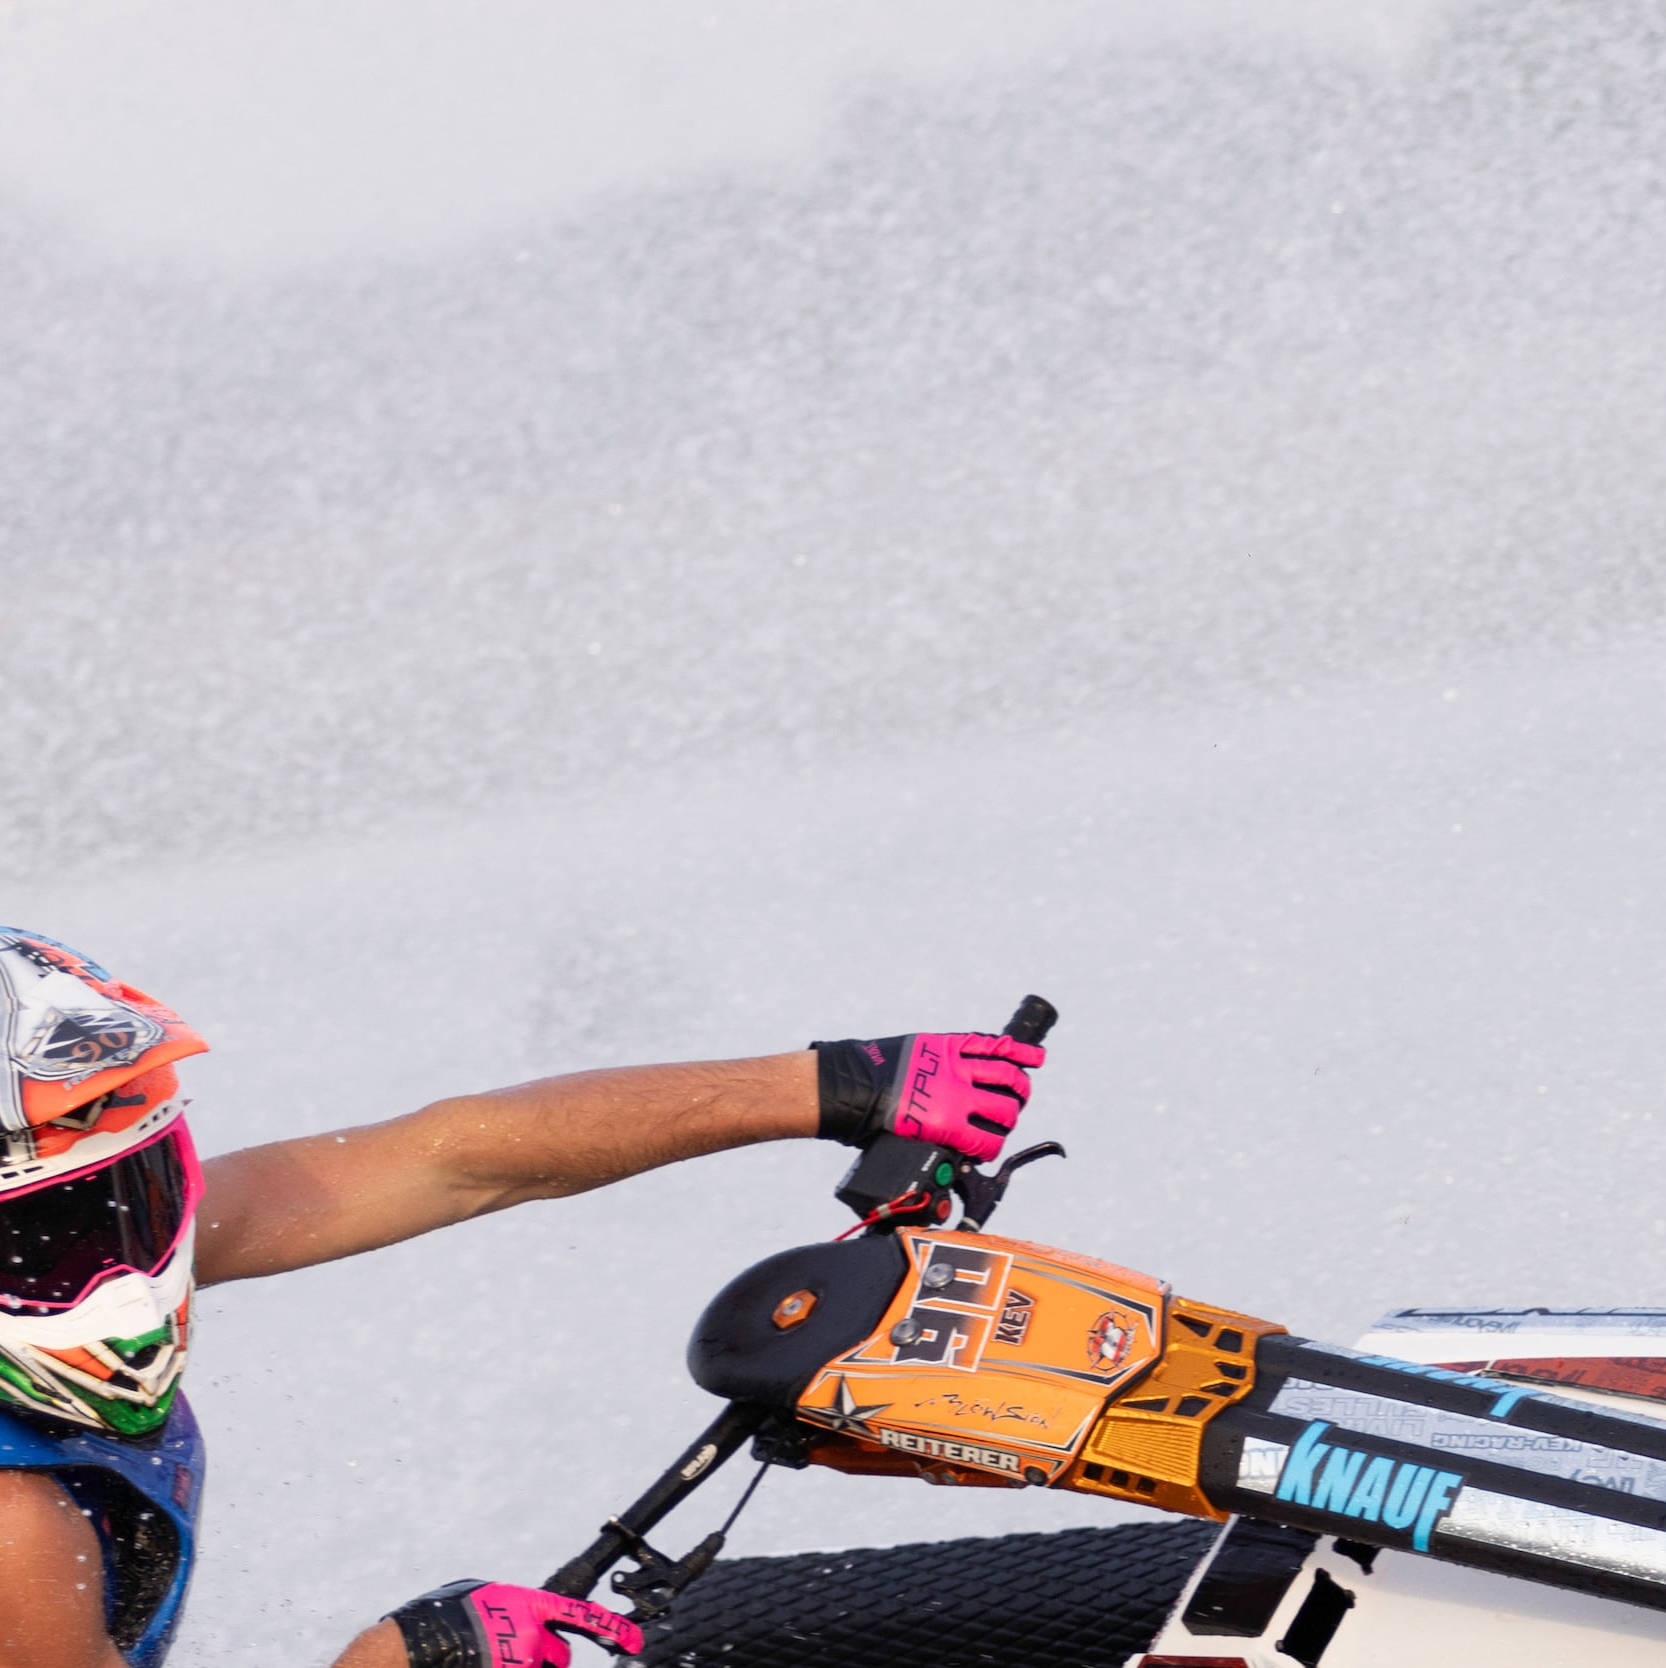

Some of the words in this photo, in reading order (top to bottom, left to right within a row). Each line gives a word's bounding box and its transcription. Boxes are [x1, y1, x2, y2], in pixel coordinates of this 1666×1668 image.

[71, 1031, 129, 1063] 90
[991, 1288, 1038, 1346] KEV
[878, 1427, 1021, 1472] REITERER
[1274, 1418, 1464, 1553] KNAUF
